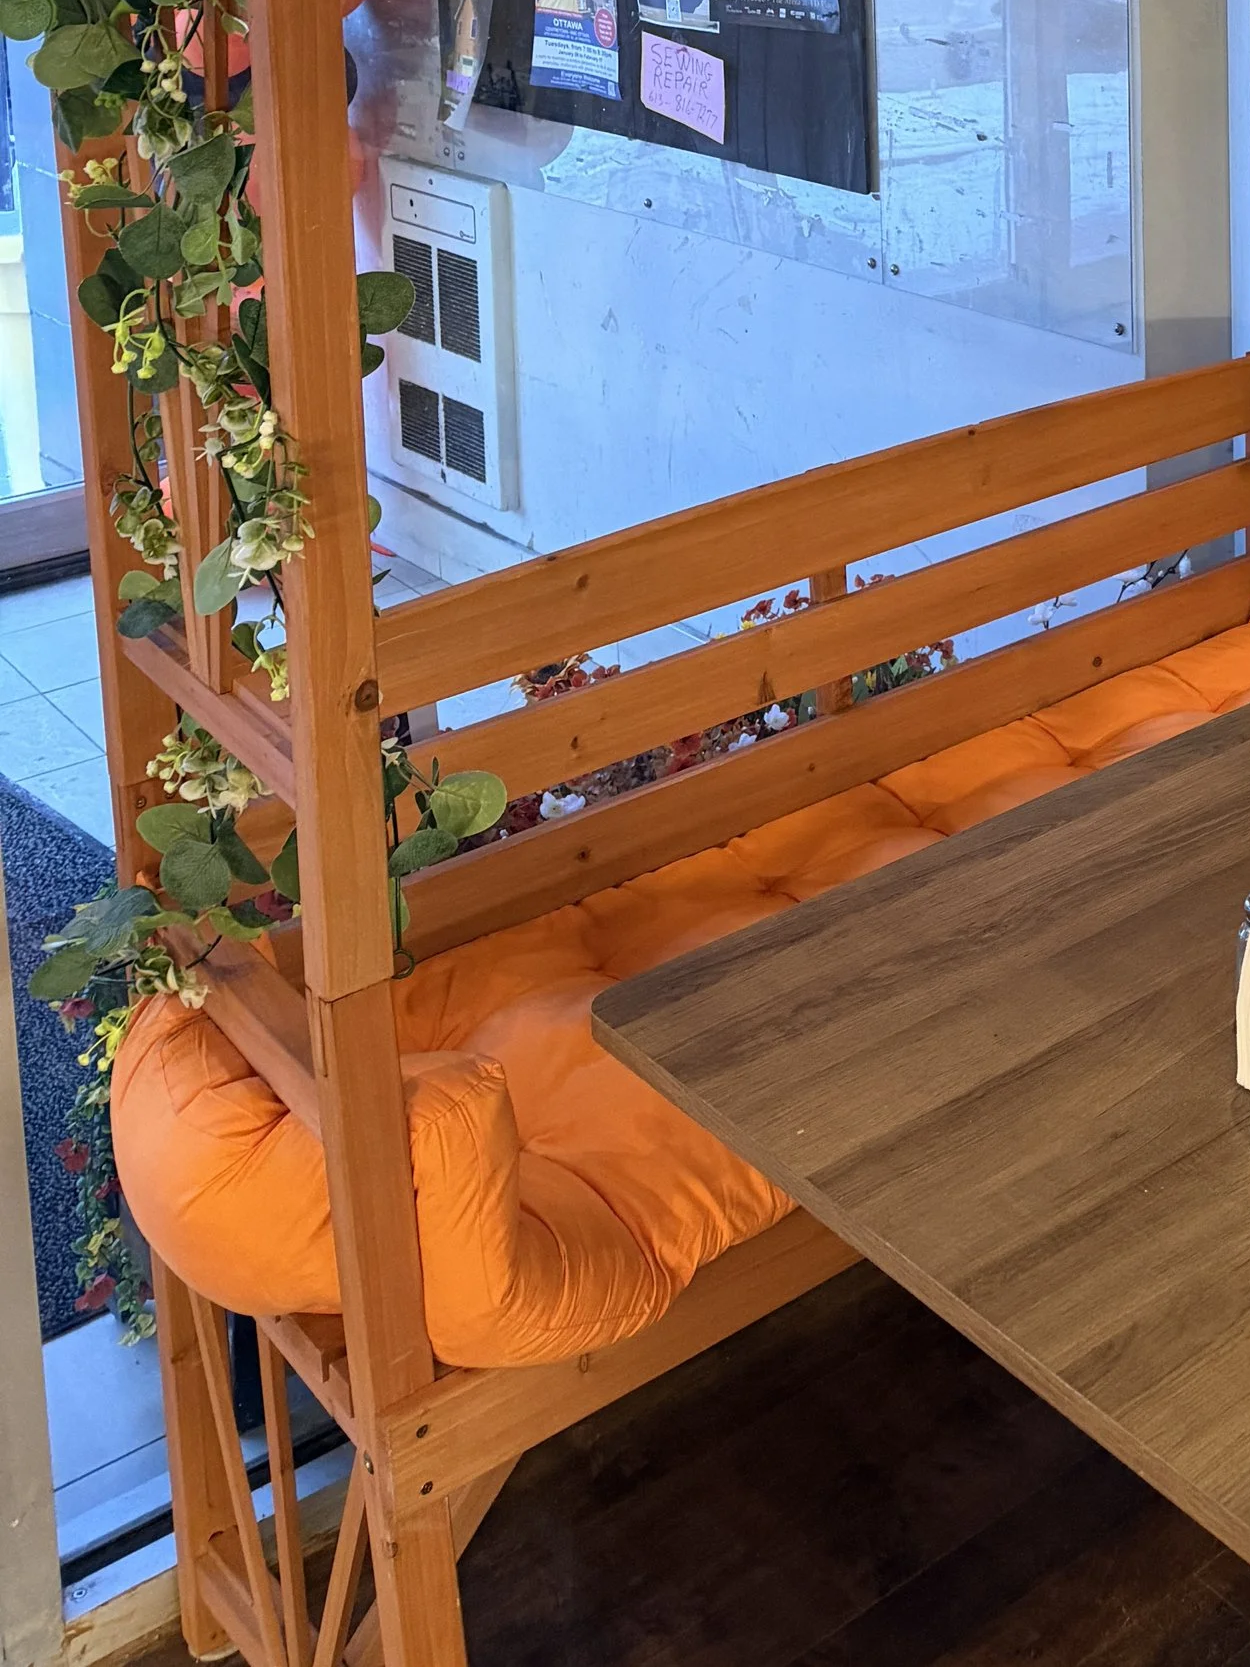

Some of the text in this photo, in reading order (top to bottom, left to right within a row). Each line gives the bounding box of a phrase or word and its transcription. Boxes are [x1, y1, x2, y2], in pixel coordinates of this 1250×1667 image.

[553, 17, 584, 31] OTTAWA
[650, 43, 713, 82] SEWING
[653, 65, 709, 100] REPAIR
